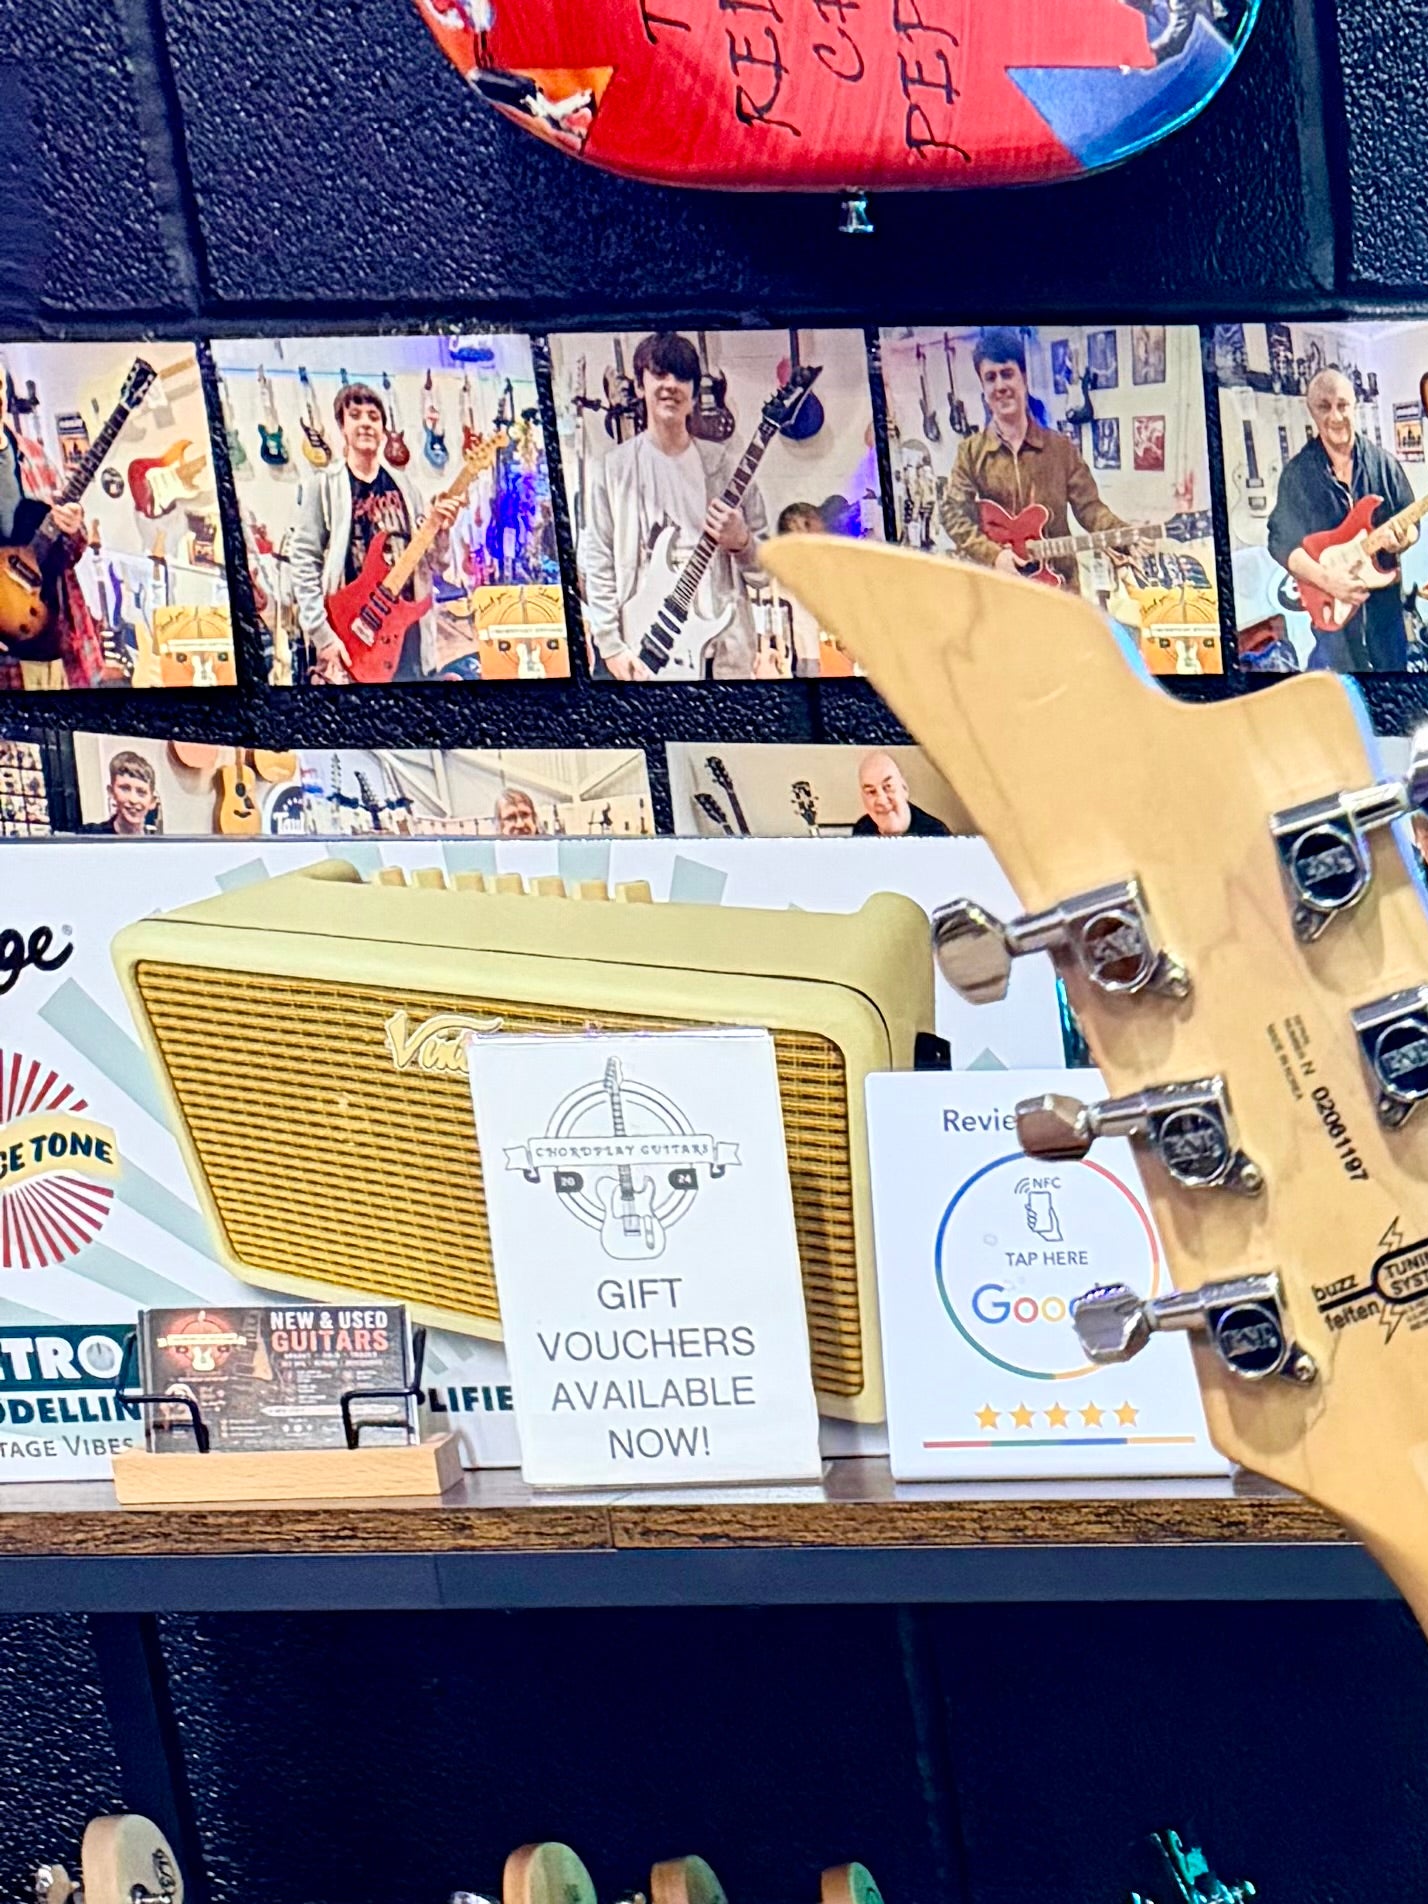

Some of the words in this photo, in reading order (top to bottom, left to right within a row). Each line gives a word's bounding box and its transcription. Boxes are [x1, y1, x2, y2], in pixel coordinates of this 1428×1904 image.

[893, 0, 971, 164] PEP
[943, 1108, 1016, 1131] Revie
[30, 1131, 114, 1164] TONE
[535, 1147, 634, 1158] CHORDPLAY
[640, 1145, 708, 1155] GUITARS
[561, 1176, 575, 1186] 20
[1033, 1177, 1061, 1189] NFC
[1005, 1252, 1038, 1266] TAP
[1044, 1251, 1089, 1265] HERE
[597, 1278, 682, 1309] GIFT
[1311, 1274, 1359, 1302] buzz
[972, 1283, 1077, 1324] Goo
[271, 1311, 313, 1330] NEW
[320, 1311, 333, 1330] &
[338, 1311, 388, 1328] USED
[271, 1330, 388, 1351] GUITARS
[537, 1326, 755, 1361] VOUCHERS
[0, 1335, 123, 1381] TRO
[427, 1386, 514, 1412] LIFIE
[552, 1376, 755, 1411] AVAILABLE
[0, 1396, 141, 1423] DELLIN
[609, 1426, 710, 1459] NOW!
